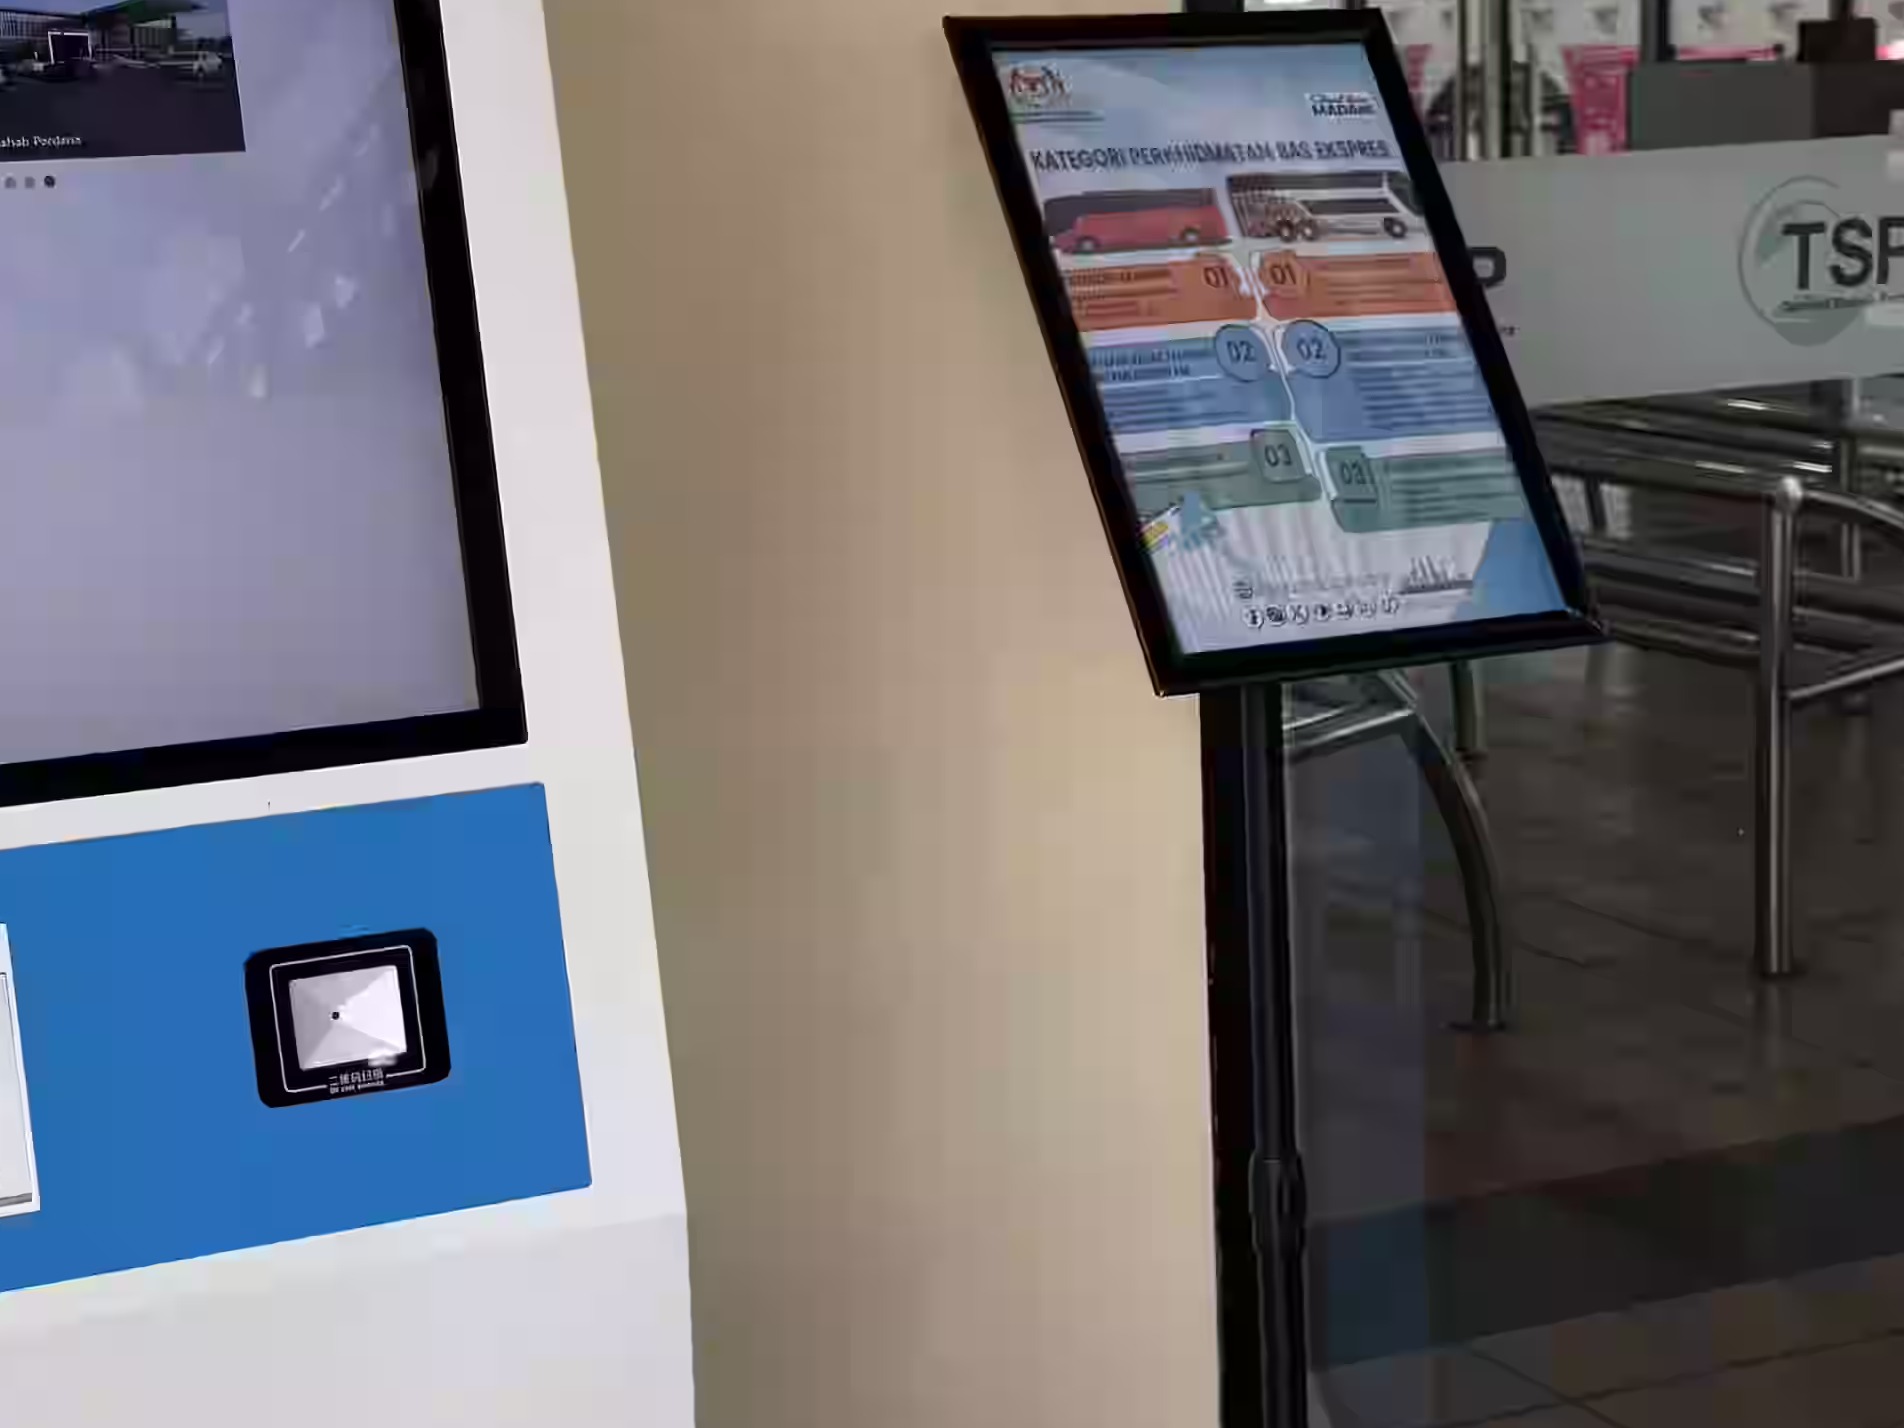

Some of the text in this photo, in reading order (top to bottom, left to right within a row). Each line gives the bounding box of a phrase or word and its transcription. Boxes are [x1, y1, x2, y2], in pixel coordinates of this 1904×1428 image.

[1029, 139, 1391, 172] KATEGORI PERKHIDMATAN BAS EKSPRES
[1204, 267, 1230, 288] 01
[1269, 263, 1296, 285] 01
[1226, 341, 1255, 364] 02
[1297, 334, 1327, 360] 02
